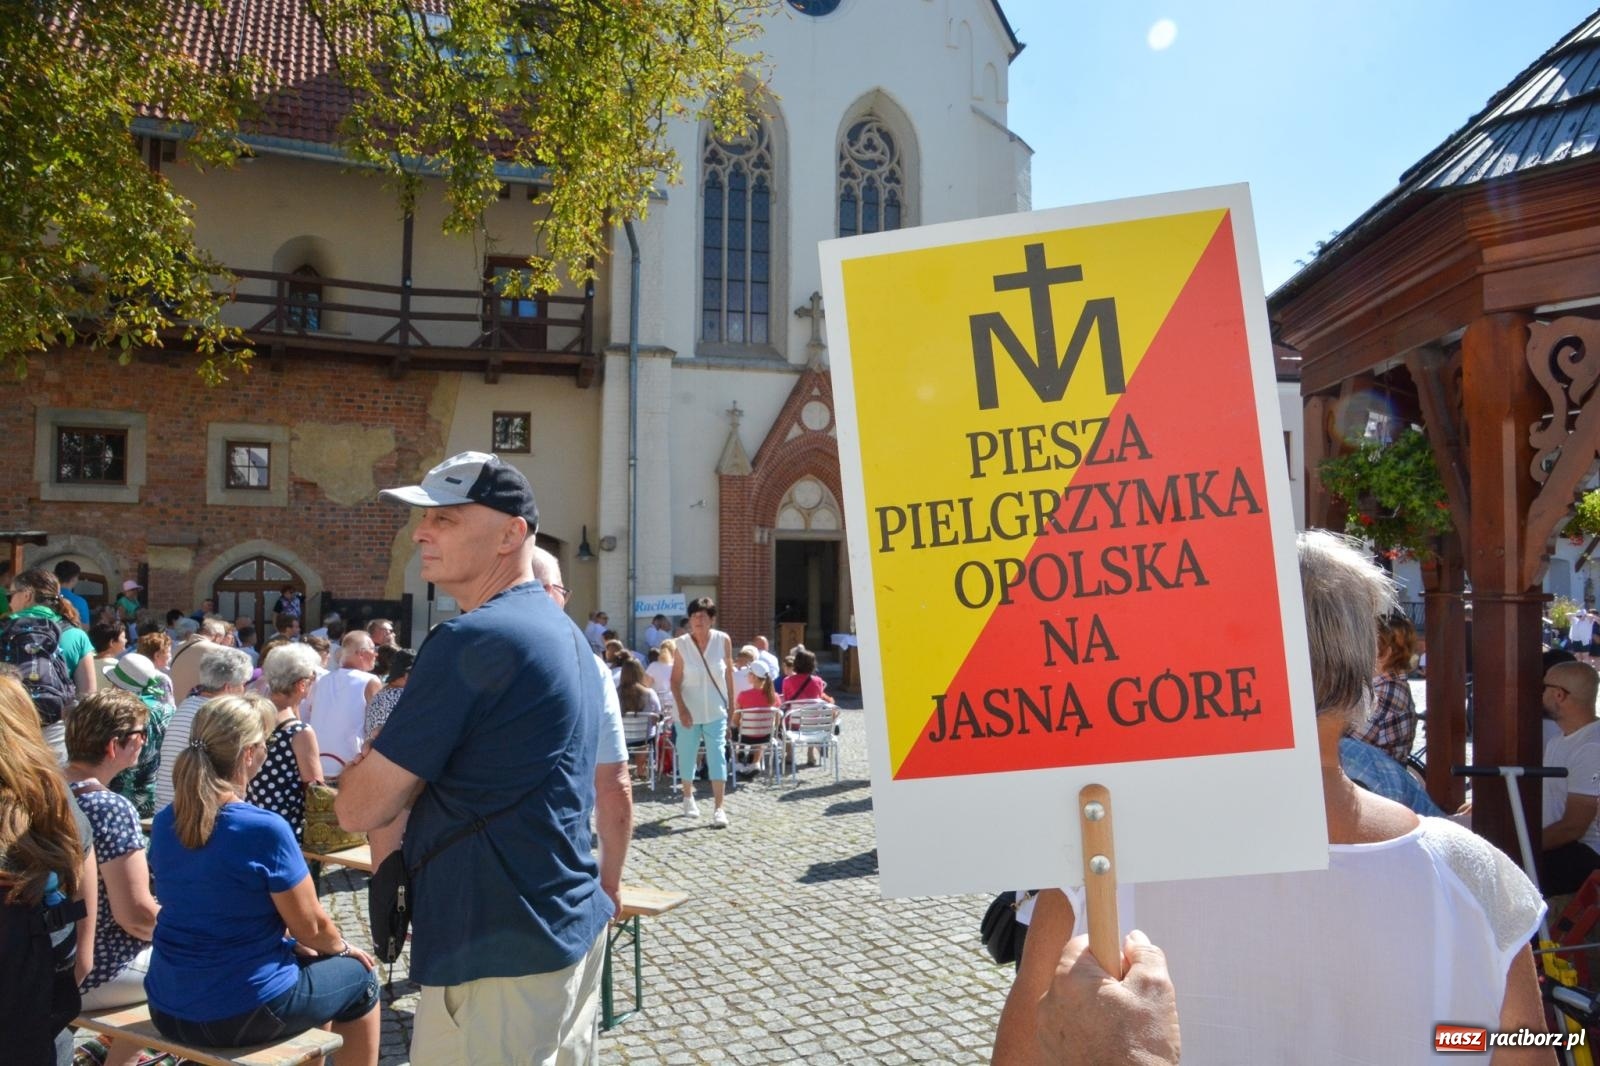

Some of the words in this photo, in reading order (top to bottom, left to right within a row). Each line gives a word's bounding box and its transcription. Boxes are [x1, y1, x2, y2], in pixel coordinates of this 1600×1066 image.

[965, 413, 1152, 479] PIESZA
[875, 467, 1263, 553] PIELGRZYMKA
[954, 538, 1209, 609] OPOLSKA
[1040, 614, 1119, 667] NA
[929, 682, 1093, 743] JASNĄ
[1107, 666, 1261, 727] GÓRĘ
